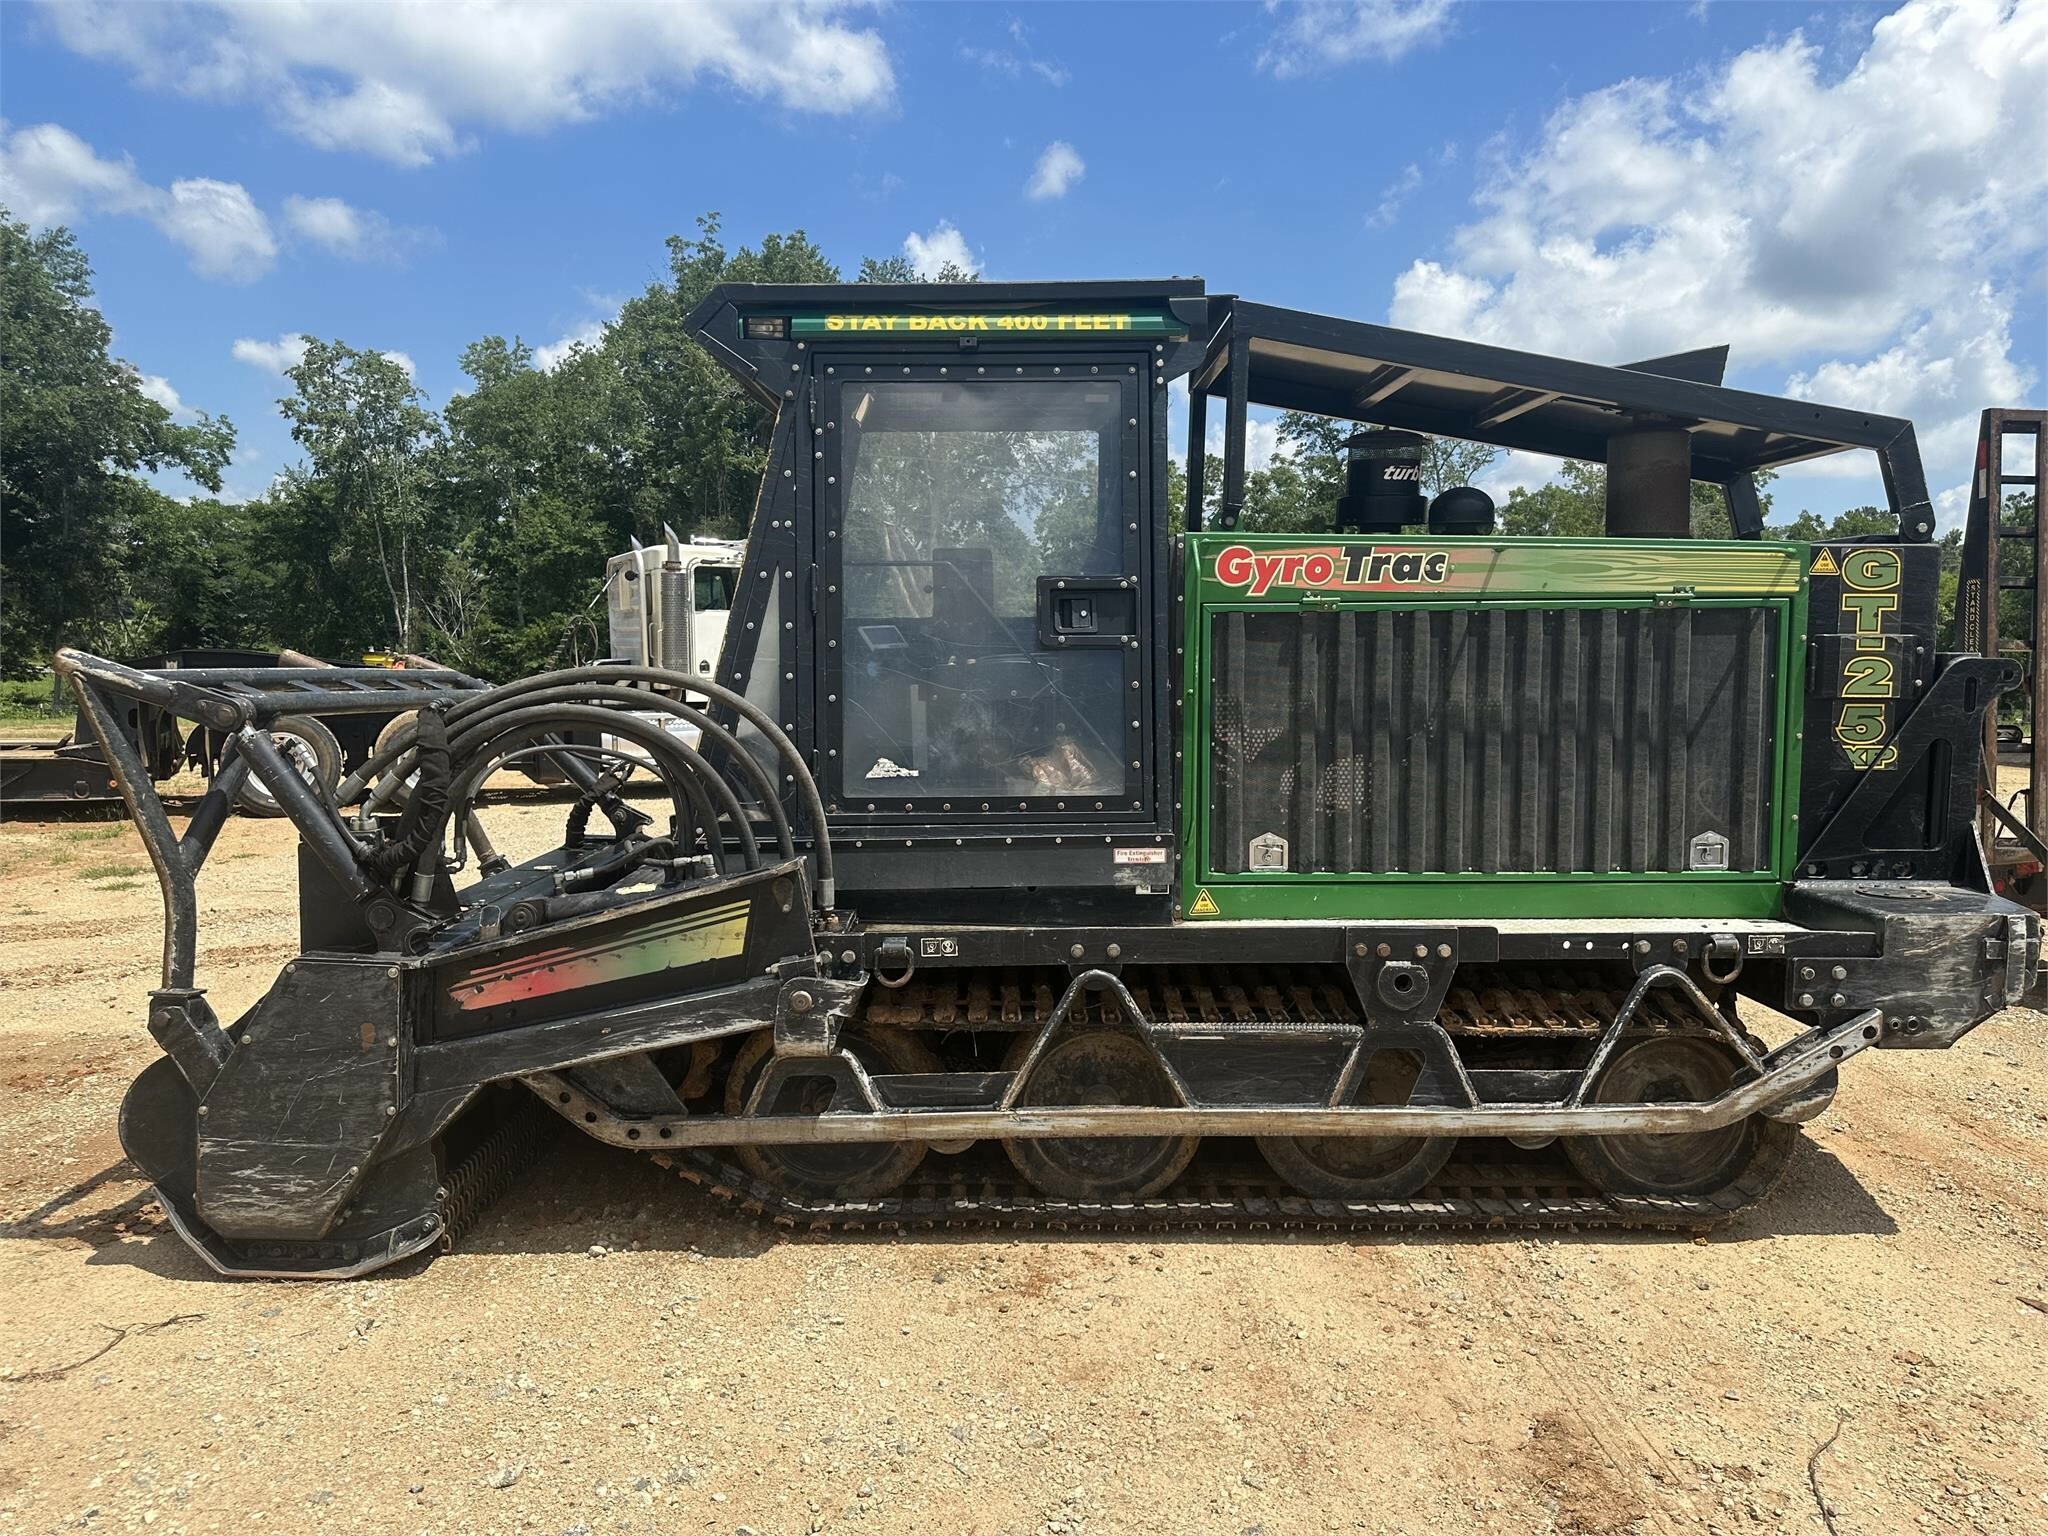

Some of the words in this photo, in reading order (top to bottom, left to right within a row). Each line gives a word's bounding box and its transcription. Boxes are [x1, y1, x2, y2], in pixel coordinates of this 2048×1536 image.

[826, 315, 898, 331] STAY
[909, 315, 988, 331] BACK
[997, 315, 1048, 331] 400
[1057, 315, 1128, 331] FEET
[1969, 584, 1977, 621] STAND
